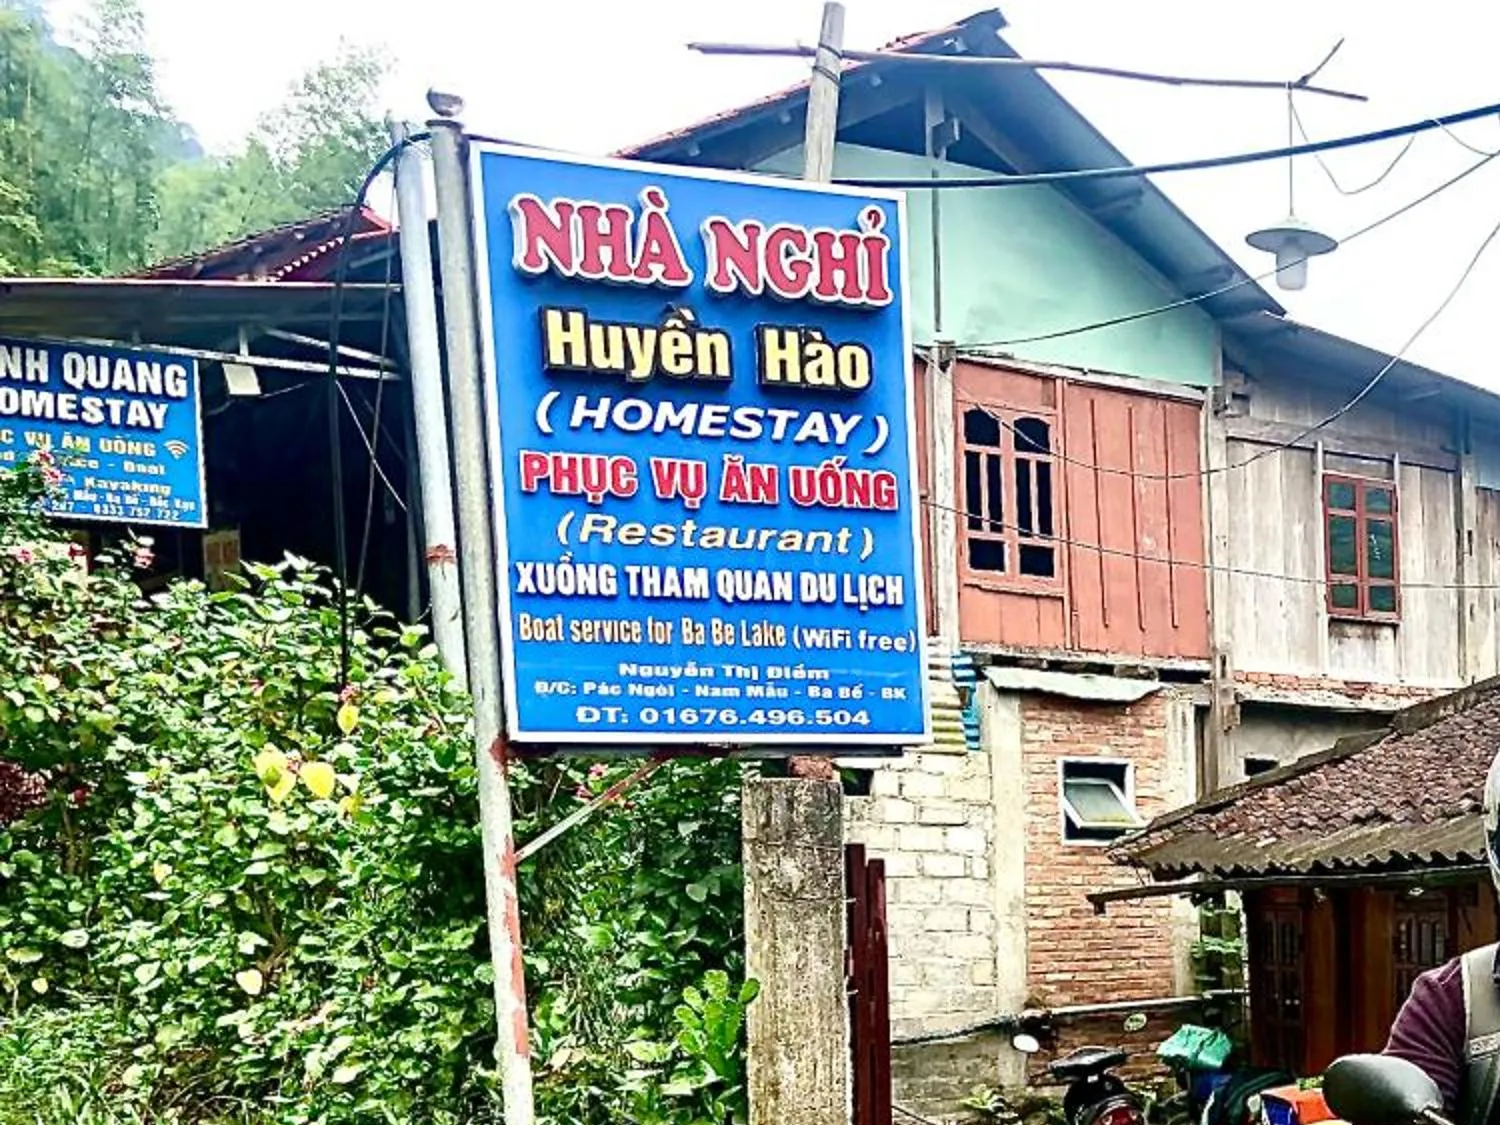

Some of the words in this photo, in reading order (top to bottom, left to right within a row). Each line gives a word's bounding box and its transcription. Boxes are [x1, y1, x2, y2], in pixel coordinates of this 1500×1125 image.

[513, 186, 693, 287] NHÀ
[706, 208, 893, 305] NGHỈ
[62, 351, 187, 398] QUANG
[544, 305, 732, 381] Huyền
[760, 324, 870, 391] Hào
[520, 451, 638, 505] PHỤC
[651, 457, 706, 509] VỤ
[720, 454, 778, 505] ĂN
[788, 456, 898, 510] UỐNG
[516, 552, 617, 597] XUỒNG
[625, 564, 709, 599] THAM
[716, 568, 791, 602] QUAN
[800, 571, 836, 600] DU
[844, 575, 904, 611] LỊCH
[519, 613, 564, 642] Boat
[570, 617, 641, 643] service
[648, 616, 672, 645] for
[681, 617, 704, 646] Ba
[711, 618, 735, 646] Be
[741, 619, 786, 647] Lake
[793, 624, 852, 650] (WiFi
[858, 629, 916, 653] free)
[639, 707, 870, 726] 01676.496.504
[695, 685, 740, 698] Nam
[808, 686, 832, 699] Ba
[881, 687, 907, 700] BK
